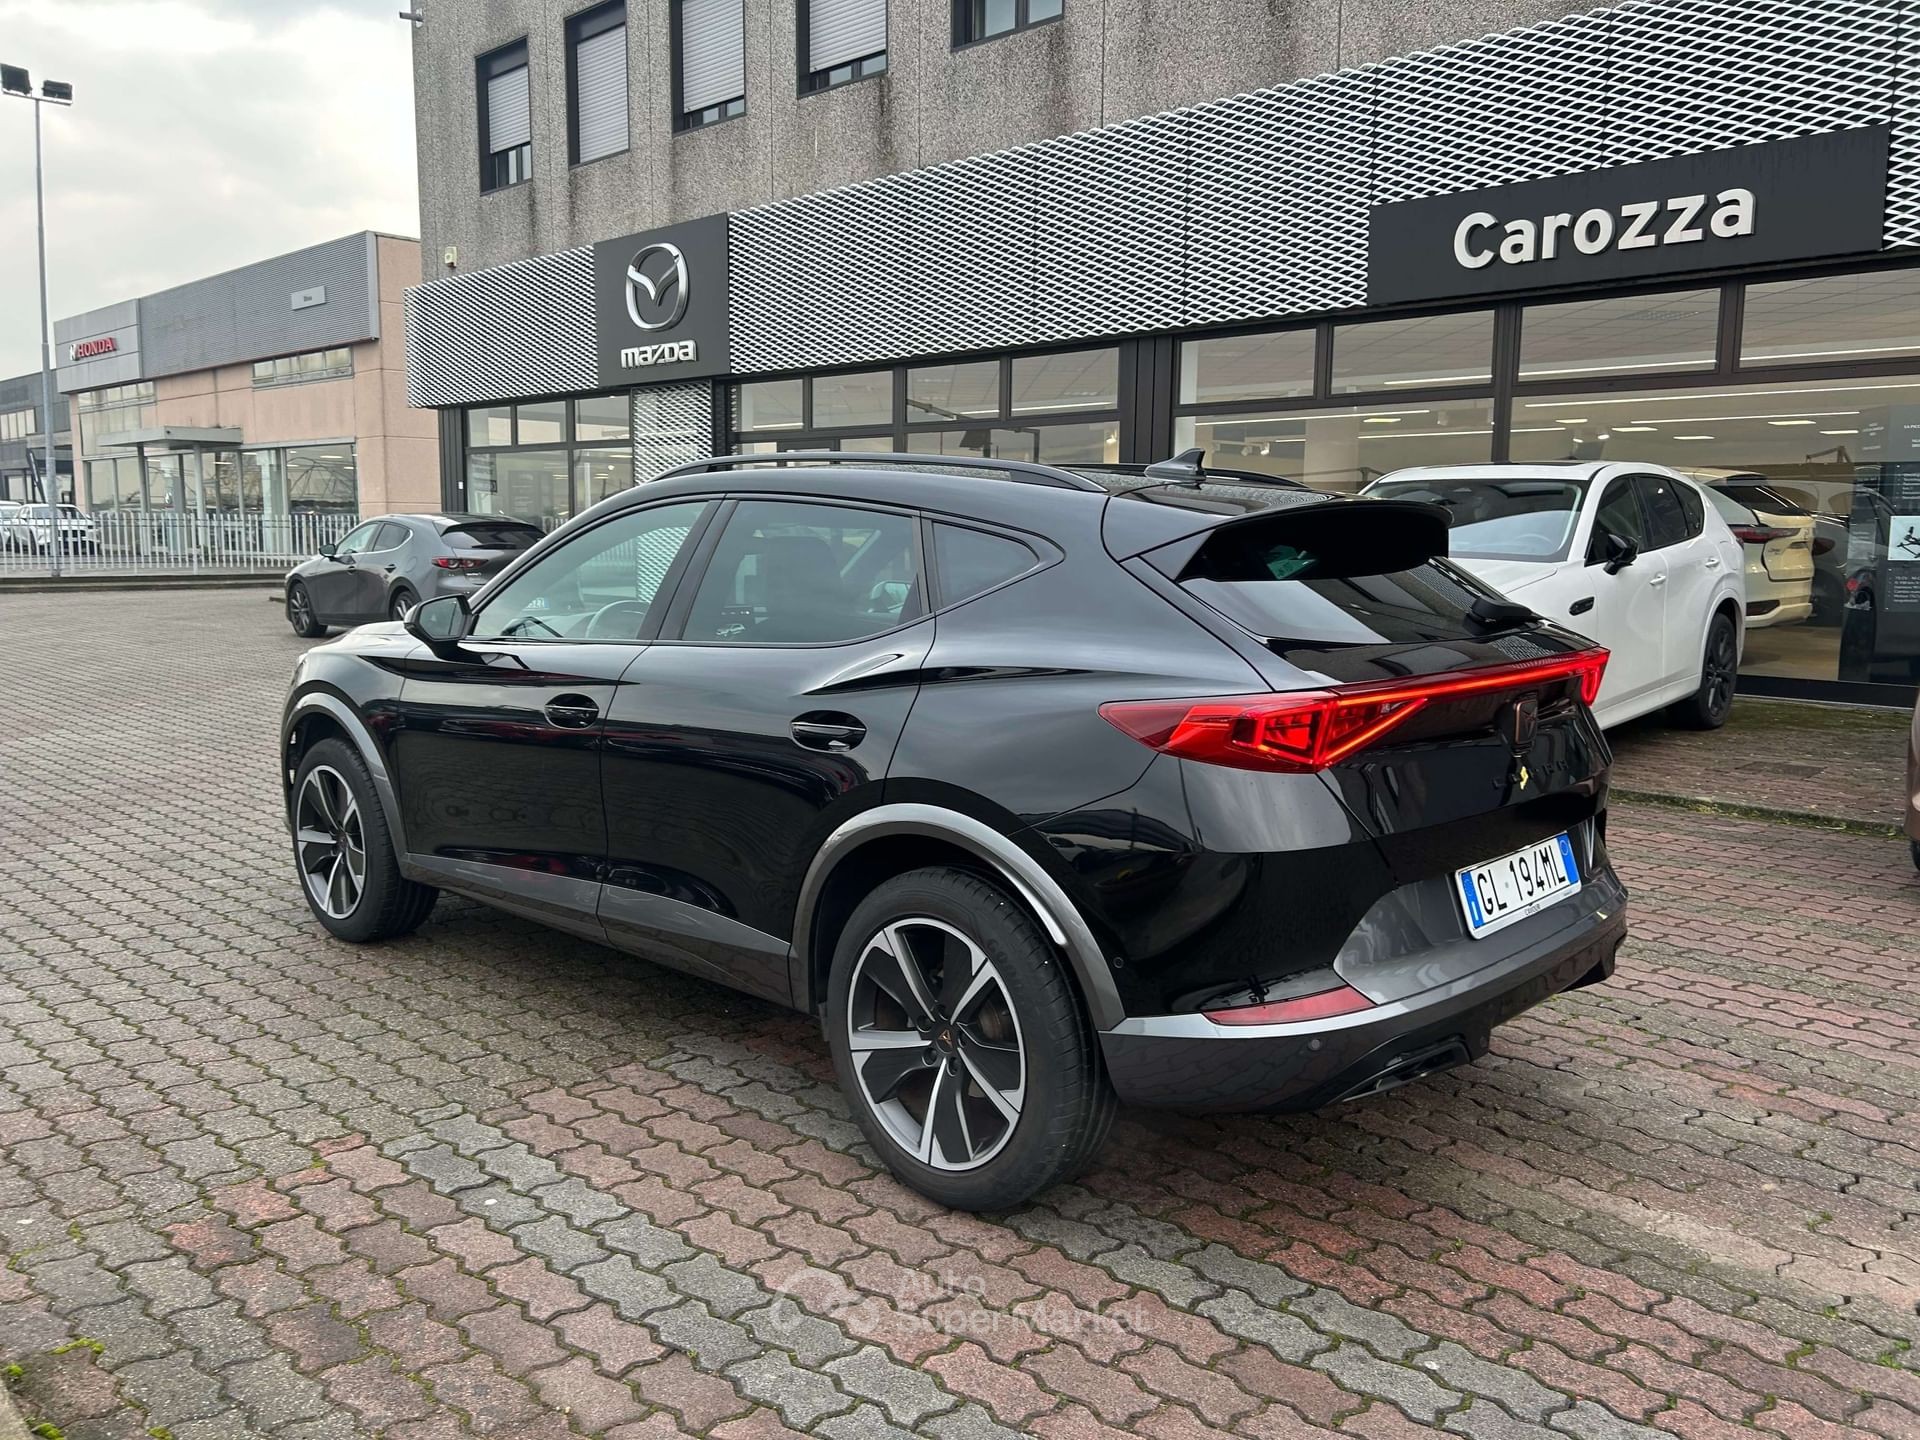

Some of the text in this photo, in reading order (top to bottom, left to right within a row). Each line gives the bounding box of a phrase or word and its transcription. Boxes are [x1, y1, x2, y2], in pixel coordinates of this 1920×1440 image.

[1454, 188, 1755, 268] Carozza
[78, 337, 115, 357] HONDA
[621, 340, 697, 368] mazda
[1478, 845, 1566, 915] GL 194ML
